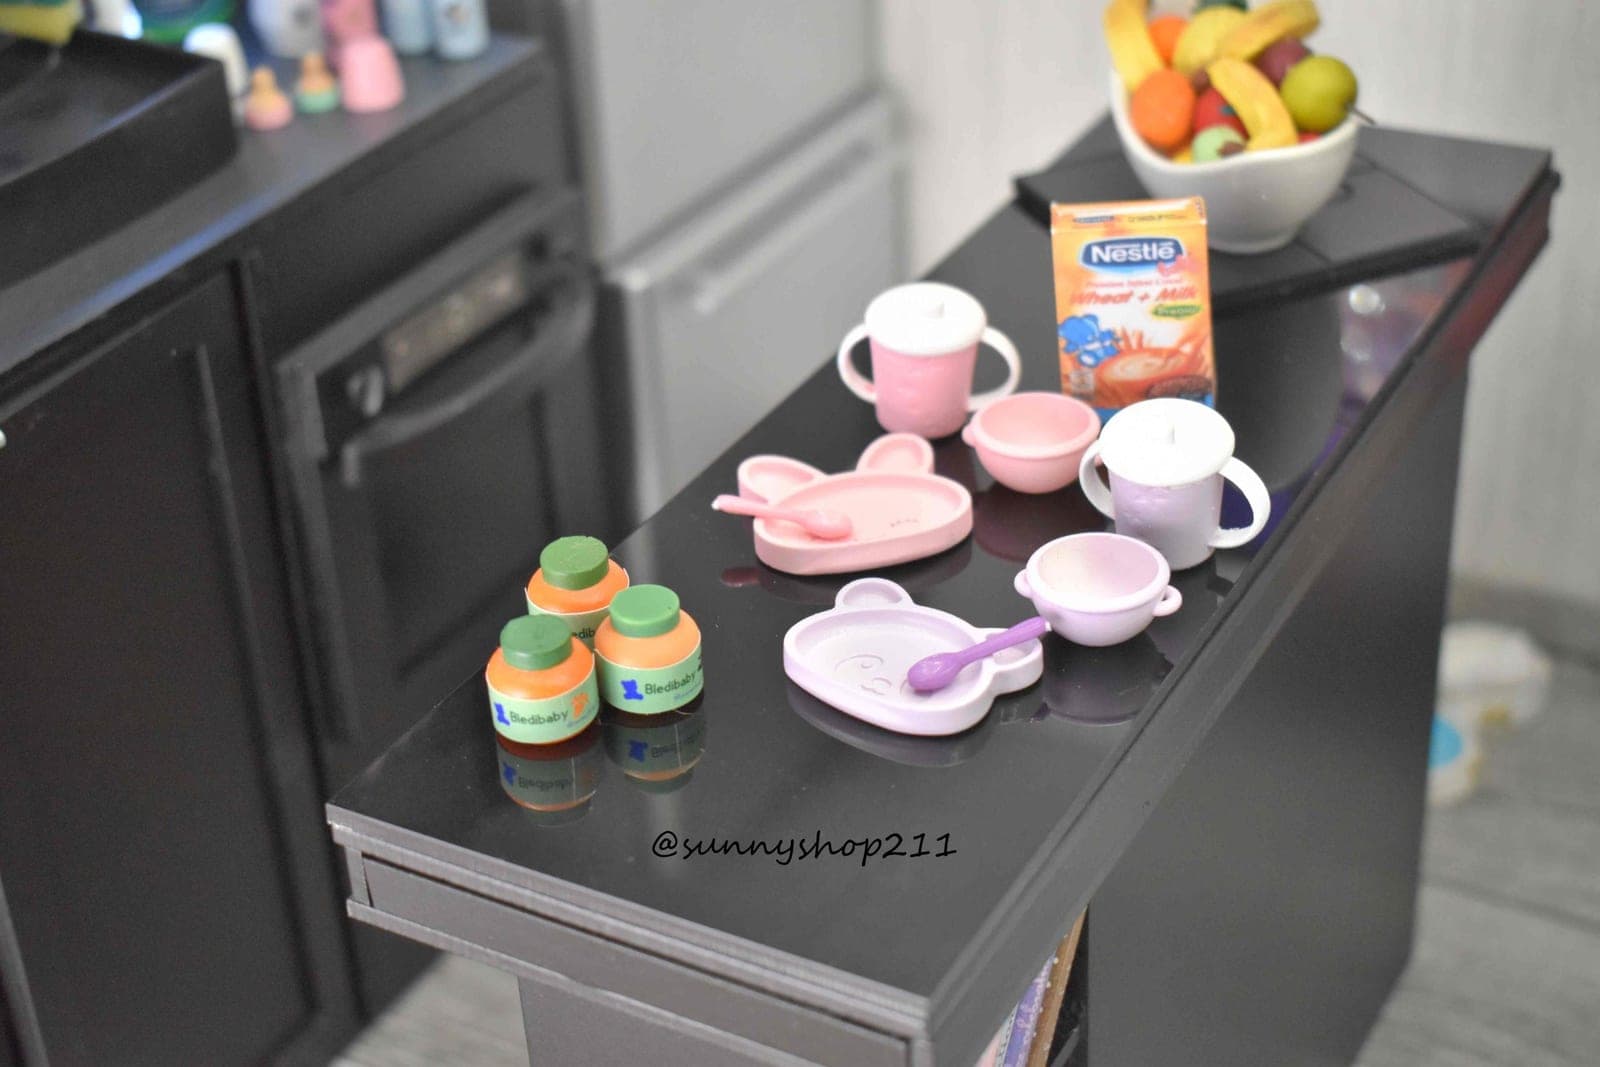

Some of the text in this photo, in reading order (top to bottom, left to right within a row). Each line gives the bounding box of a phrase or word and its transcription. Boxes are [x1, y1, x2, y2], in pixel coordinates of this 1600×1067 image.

[1070, 291, 1133, 305] Wheat
[1156, 287, 1197, 302] Milk
[644, 672, 695, 695] Bledibaby
[510, 709, 568, 725] Bledibaby
